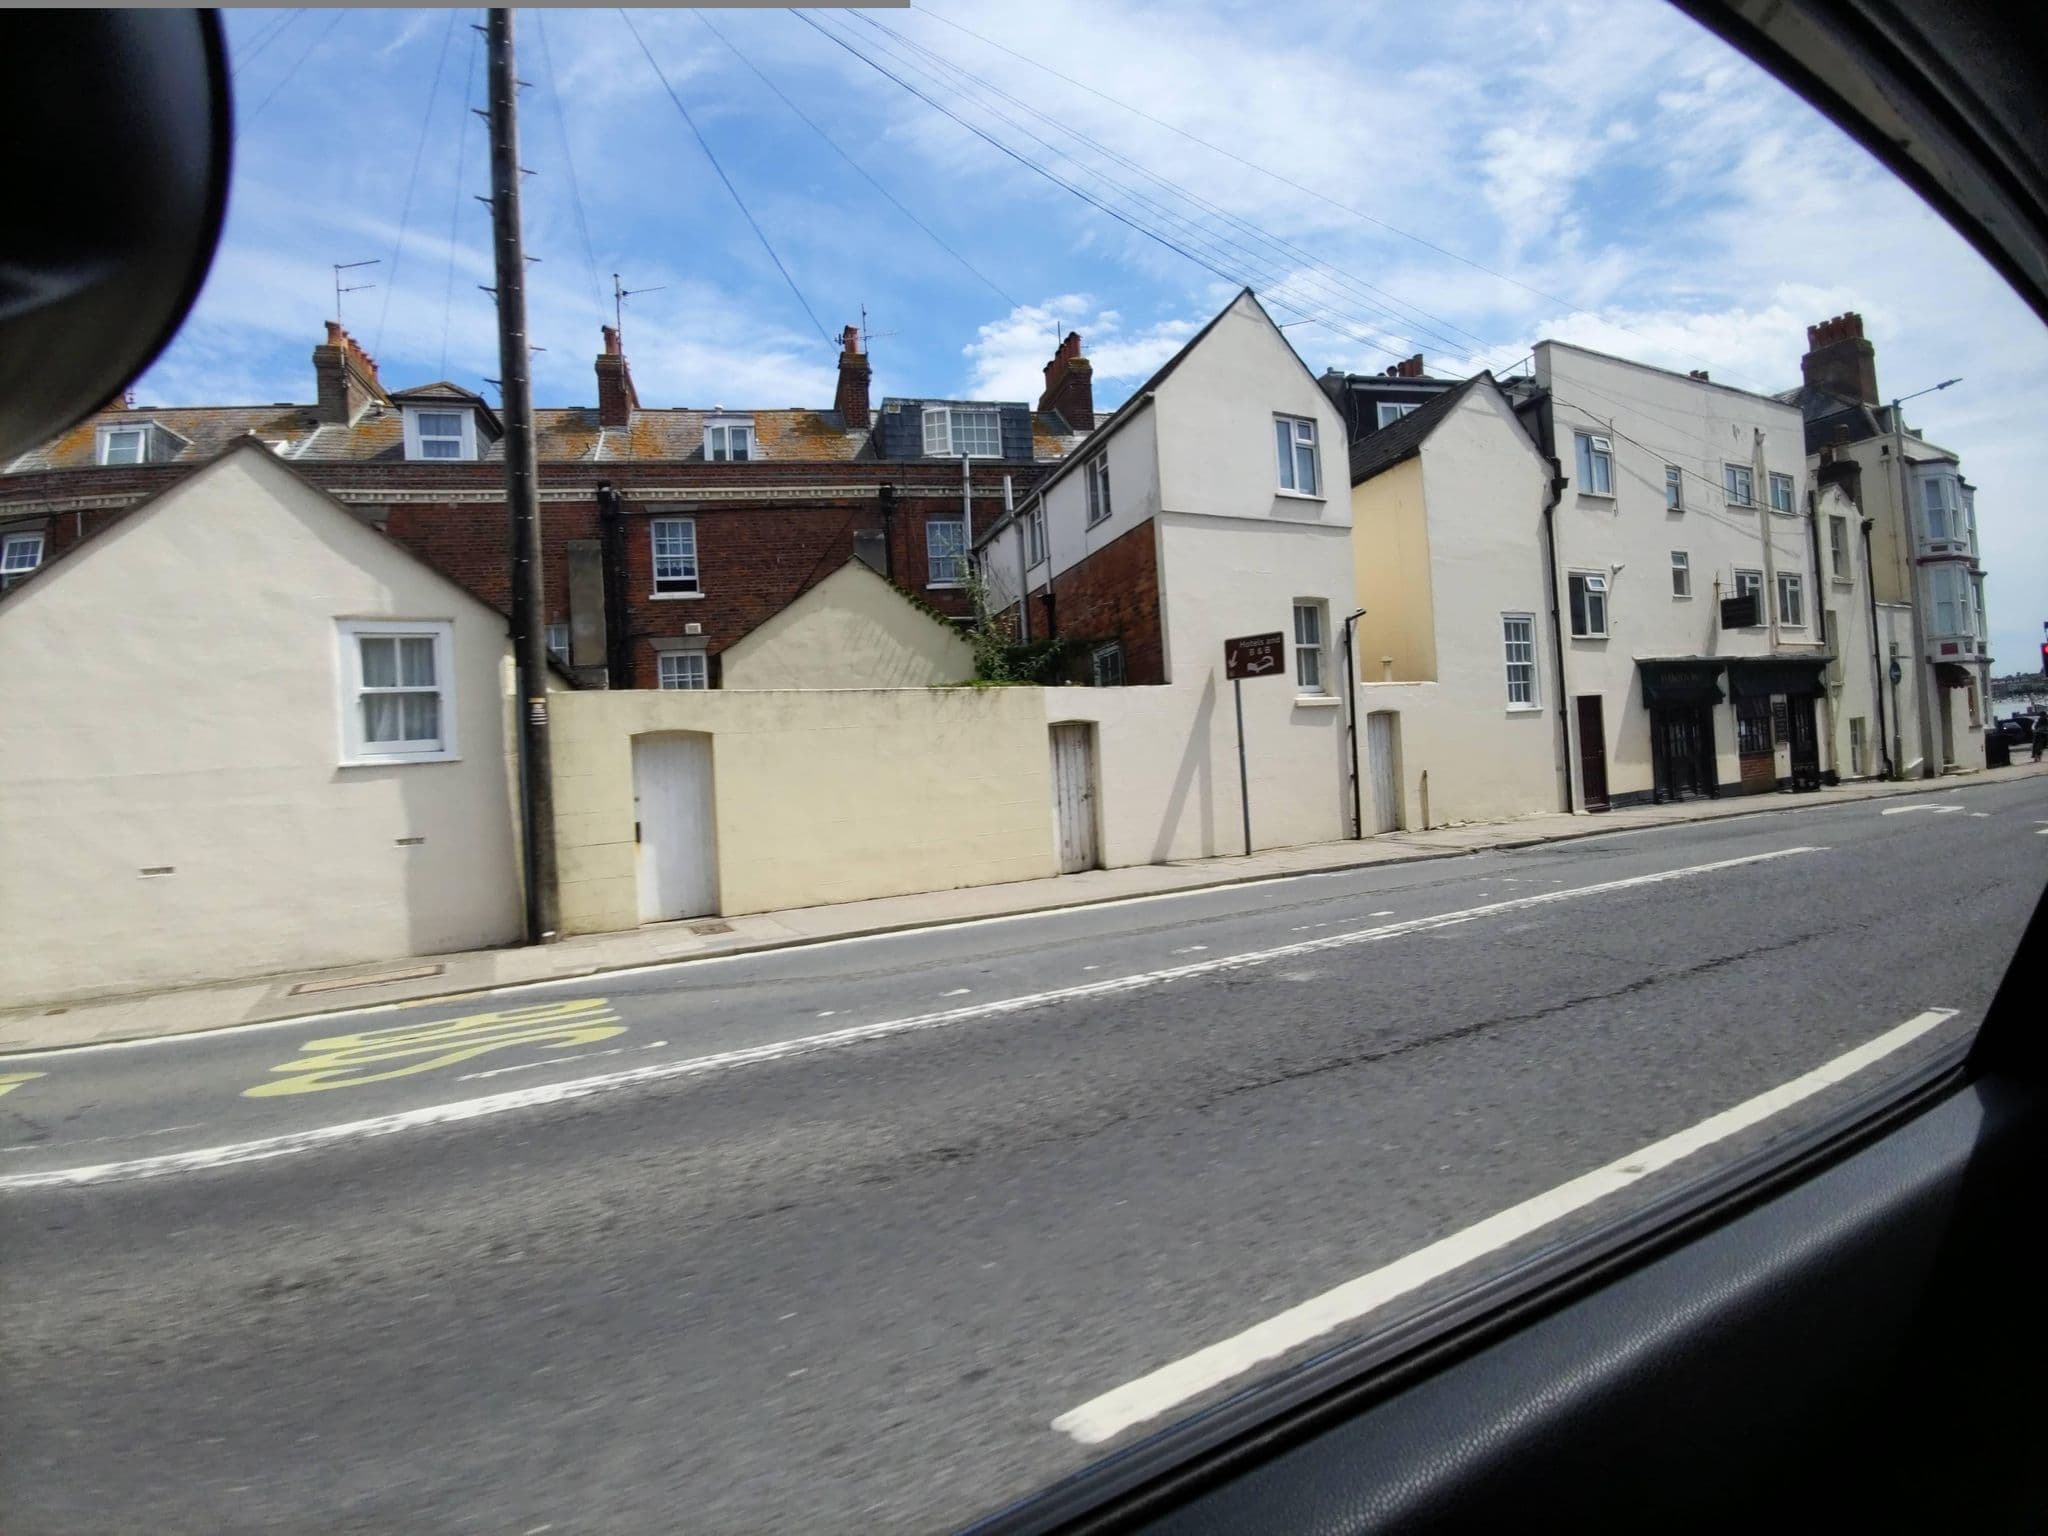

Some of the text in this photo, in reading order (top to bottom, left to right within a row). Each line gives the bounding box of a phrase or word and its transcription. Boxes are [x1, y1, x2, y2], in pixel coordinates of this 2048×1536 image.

[1240, 637, 1280, 648] Hotels and
[241, 998, 628, 1097] BUS
